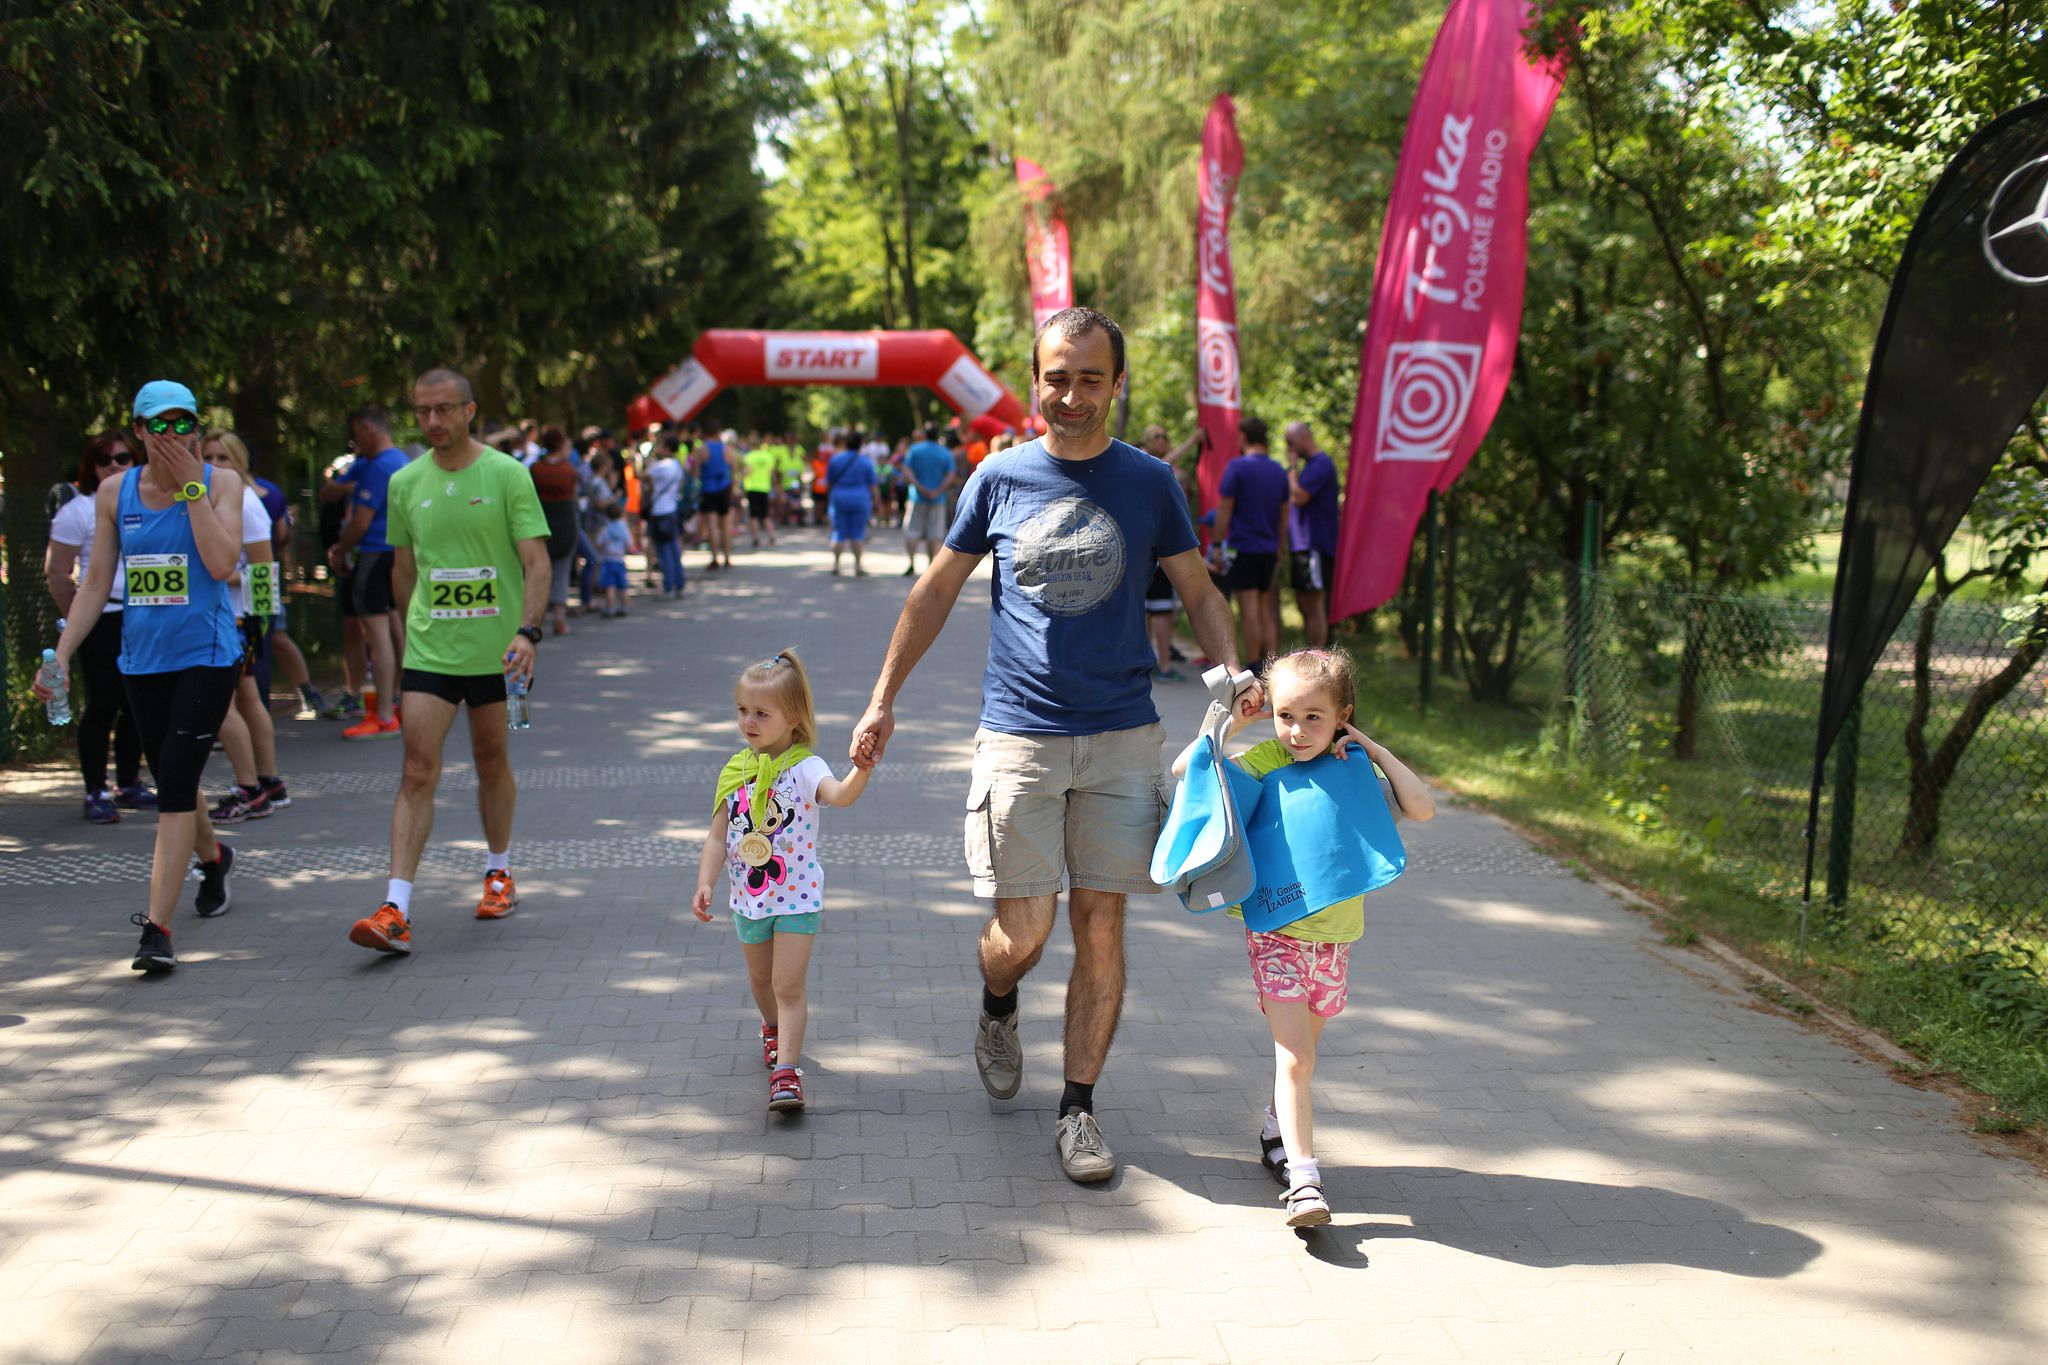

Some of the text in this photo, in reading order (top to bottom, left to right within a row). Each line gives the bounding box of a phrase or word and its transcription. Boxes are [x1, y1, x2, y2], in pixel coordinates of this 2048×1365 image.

[1403, 114, 1474, 321] Trójka
[1461, 128, 1507, 311] POLSKIE RADIO
[776, 348, 865, 370] START
[129, 570, 185, 593] 208
[253, 565, 271, 611] 336
[433, 582, 496, 606] 264
[1267, 888, 1306, 913] IZABELIN
[1278, 882, 1302, 896] Gmina
